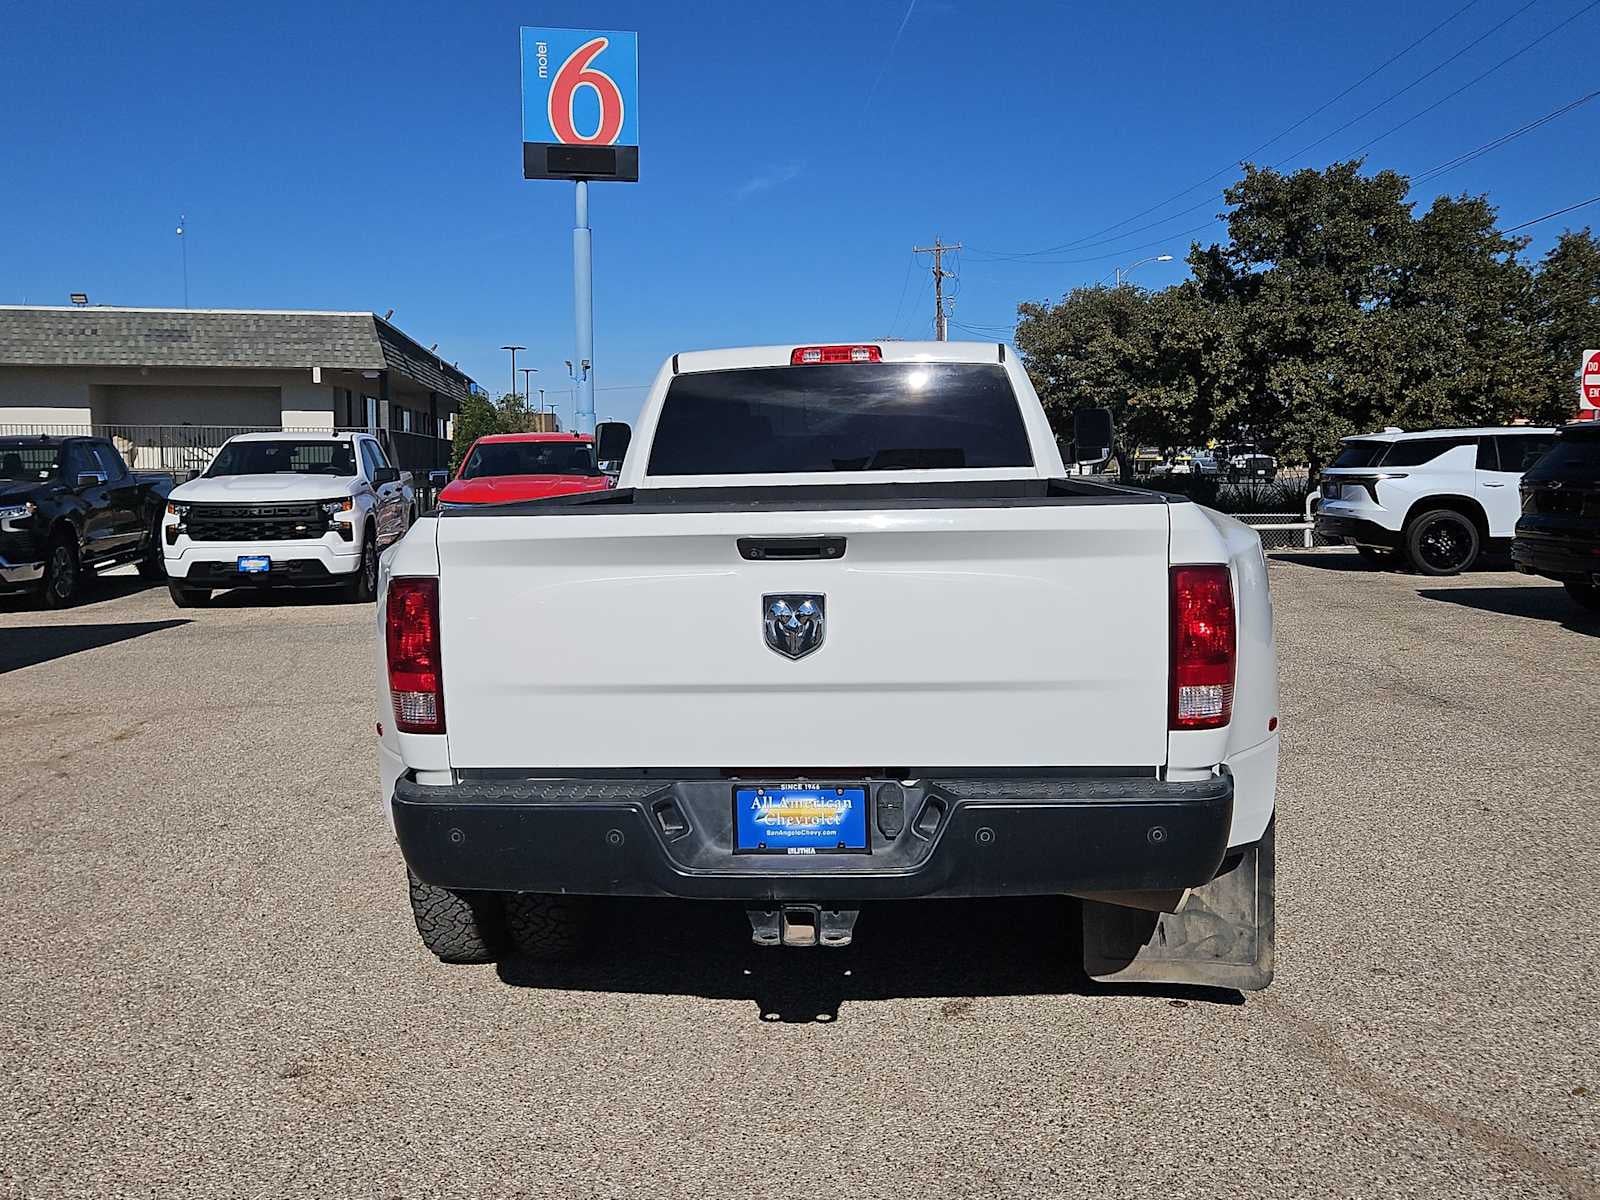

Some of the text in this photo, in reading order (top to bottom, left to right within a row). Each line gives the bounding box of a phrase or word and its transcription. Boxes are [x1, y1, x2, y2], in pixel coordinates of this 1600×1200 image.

[536, 41, 548, 79] motel
[548, 36, 624, 145] 6
[750, 796, 852, 809] All American
[764, 812, 841, 826] Chevrolet
